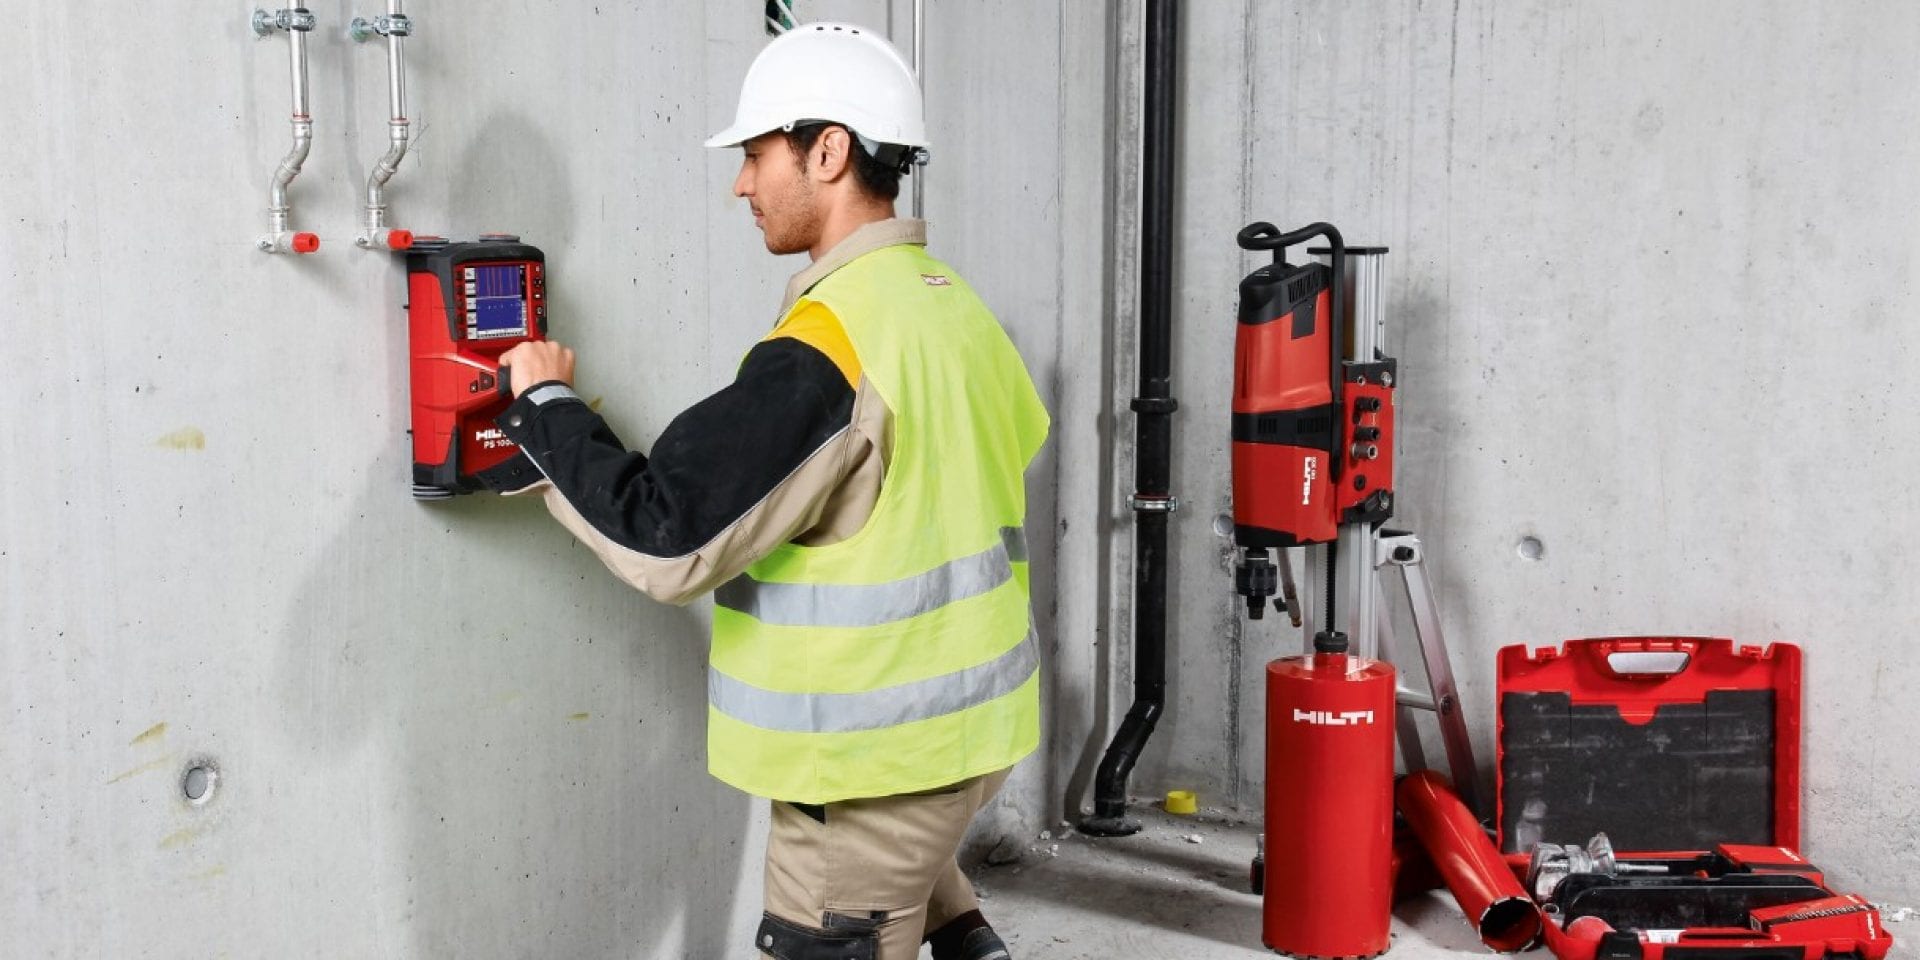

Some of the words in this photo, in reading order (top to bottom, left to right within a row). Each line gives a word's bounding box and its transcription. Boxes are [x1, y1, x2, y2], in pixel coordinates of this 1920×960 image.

[475, 429, 507, 441] HIL
[1302, 456, 1311, 505] HILTI
[1294, 708, 1374, 726] HILTI
